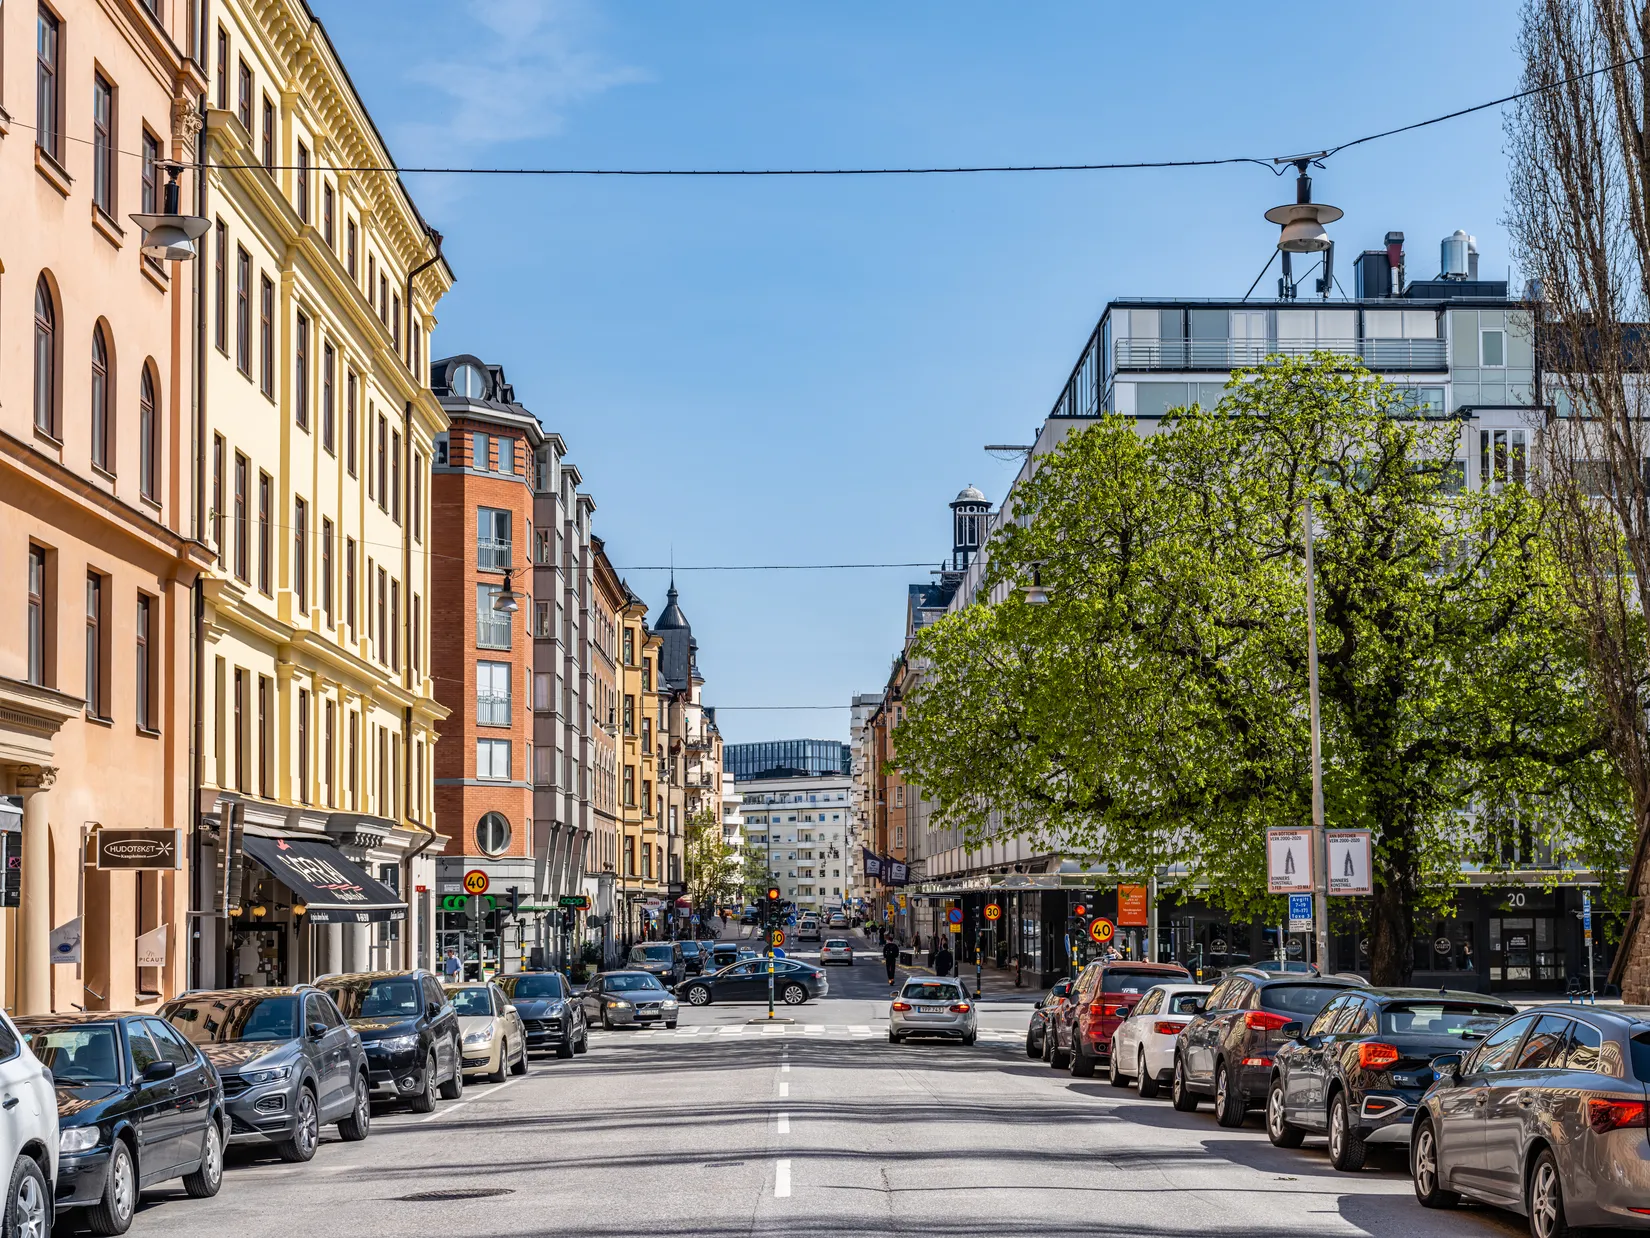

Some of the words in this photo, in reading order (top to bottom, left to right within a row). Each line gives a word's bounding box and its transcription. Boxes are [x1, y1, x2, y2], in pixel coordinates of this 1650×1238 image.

[468, 876, 485, 888] 40
[1508, 893, 1525, 906] 20
[988, 908, 998, 916] 30
[1093, 925, 1110, 936] 40
